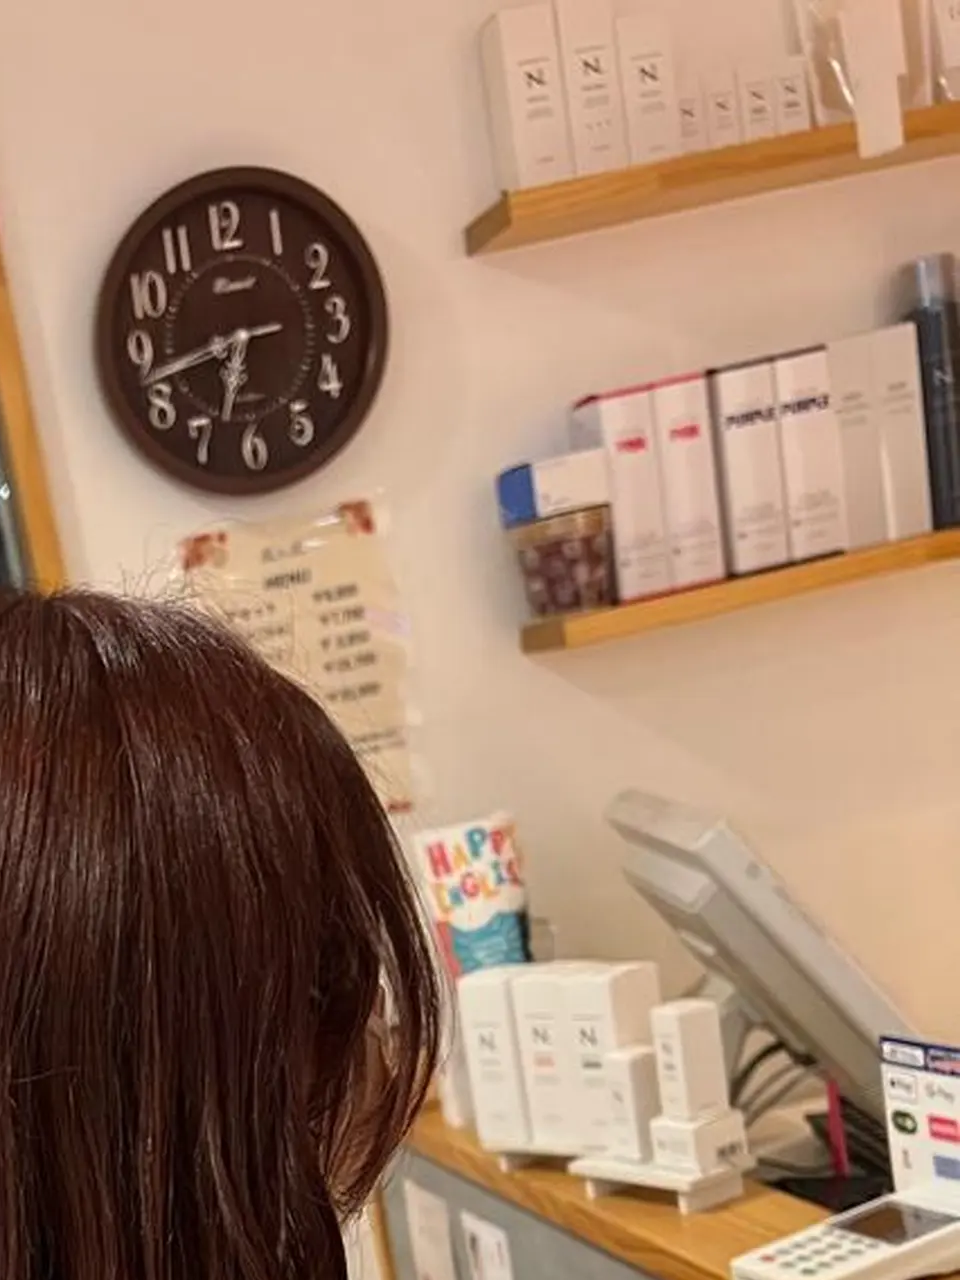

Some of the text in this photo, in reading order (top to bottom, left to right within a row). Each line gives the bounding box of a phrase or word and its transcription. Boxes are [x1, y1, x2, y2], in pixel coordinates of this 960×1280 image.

[162, 225, 190, 274] 11
[209, 201, 243, 251] 12
[269, 209, 283, 255] 1
[305, 243, 330, 290] 2
[130, 270, 167, 320] 10
[324, 297, 351, 344] 3
[127, 330, 154, 382] 9
[318, 353, 343, 398] 4
[148, 382, 176, 430] 8
[289, 399, 313, 446] 5
[188, 417, 212, 464] 7
[242, 423, 268, 470] 6
